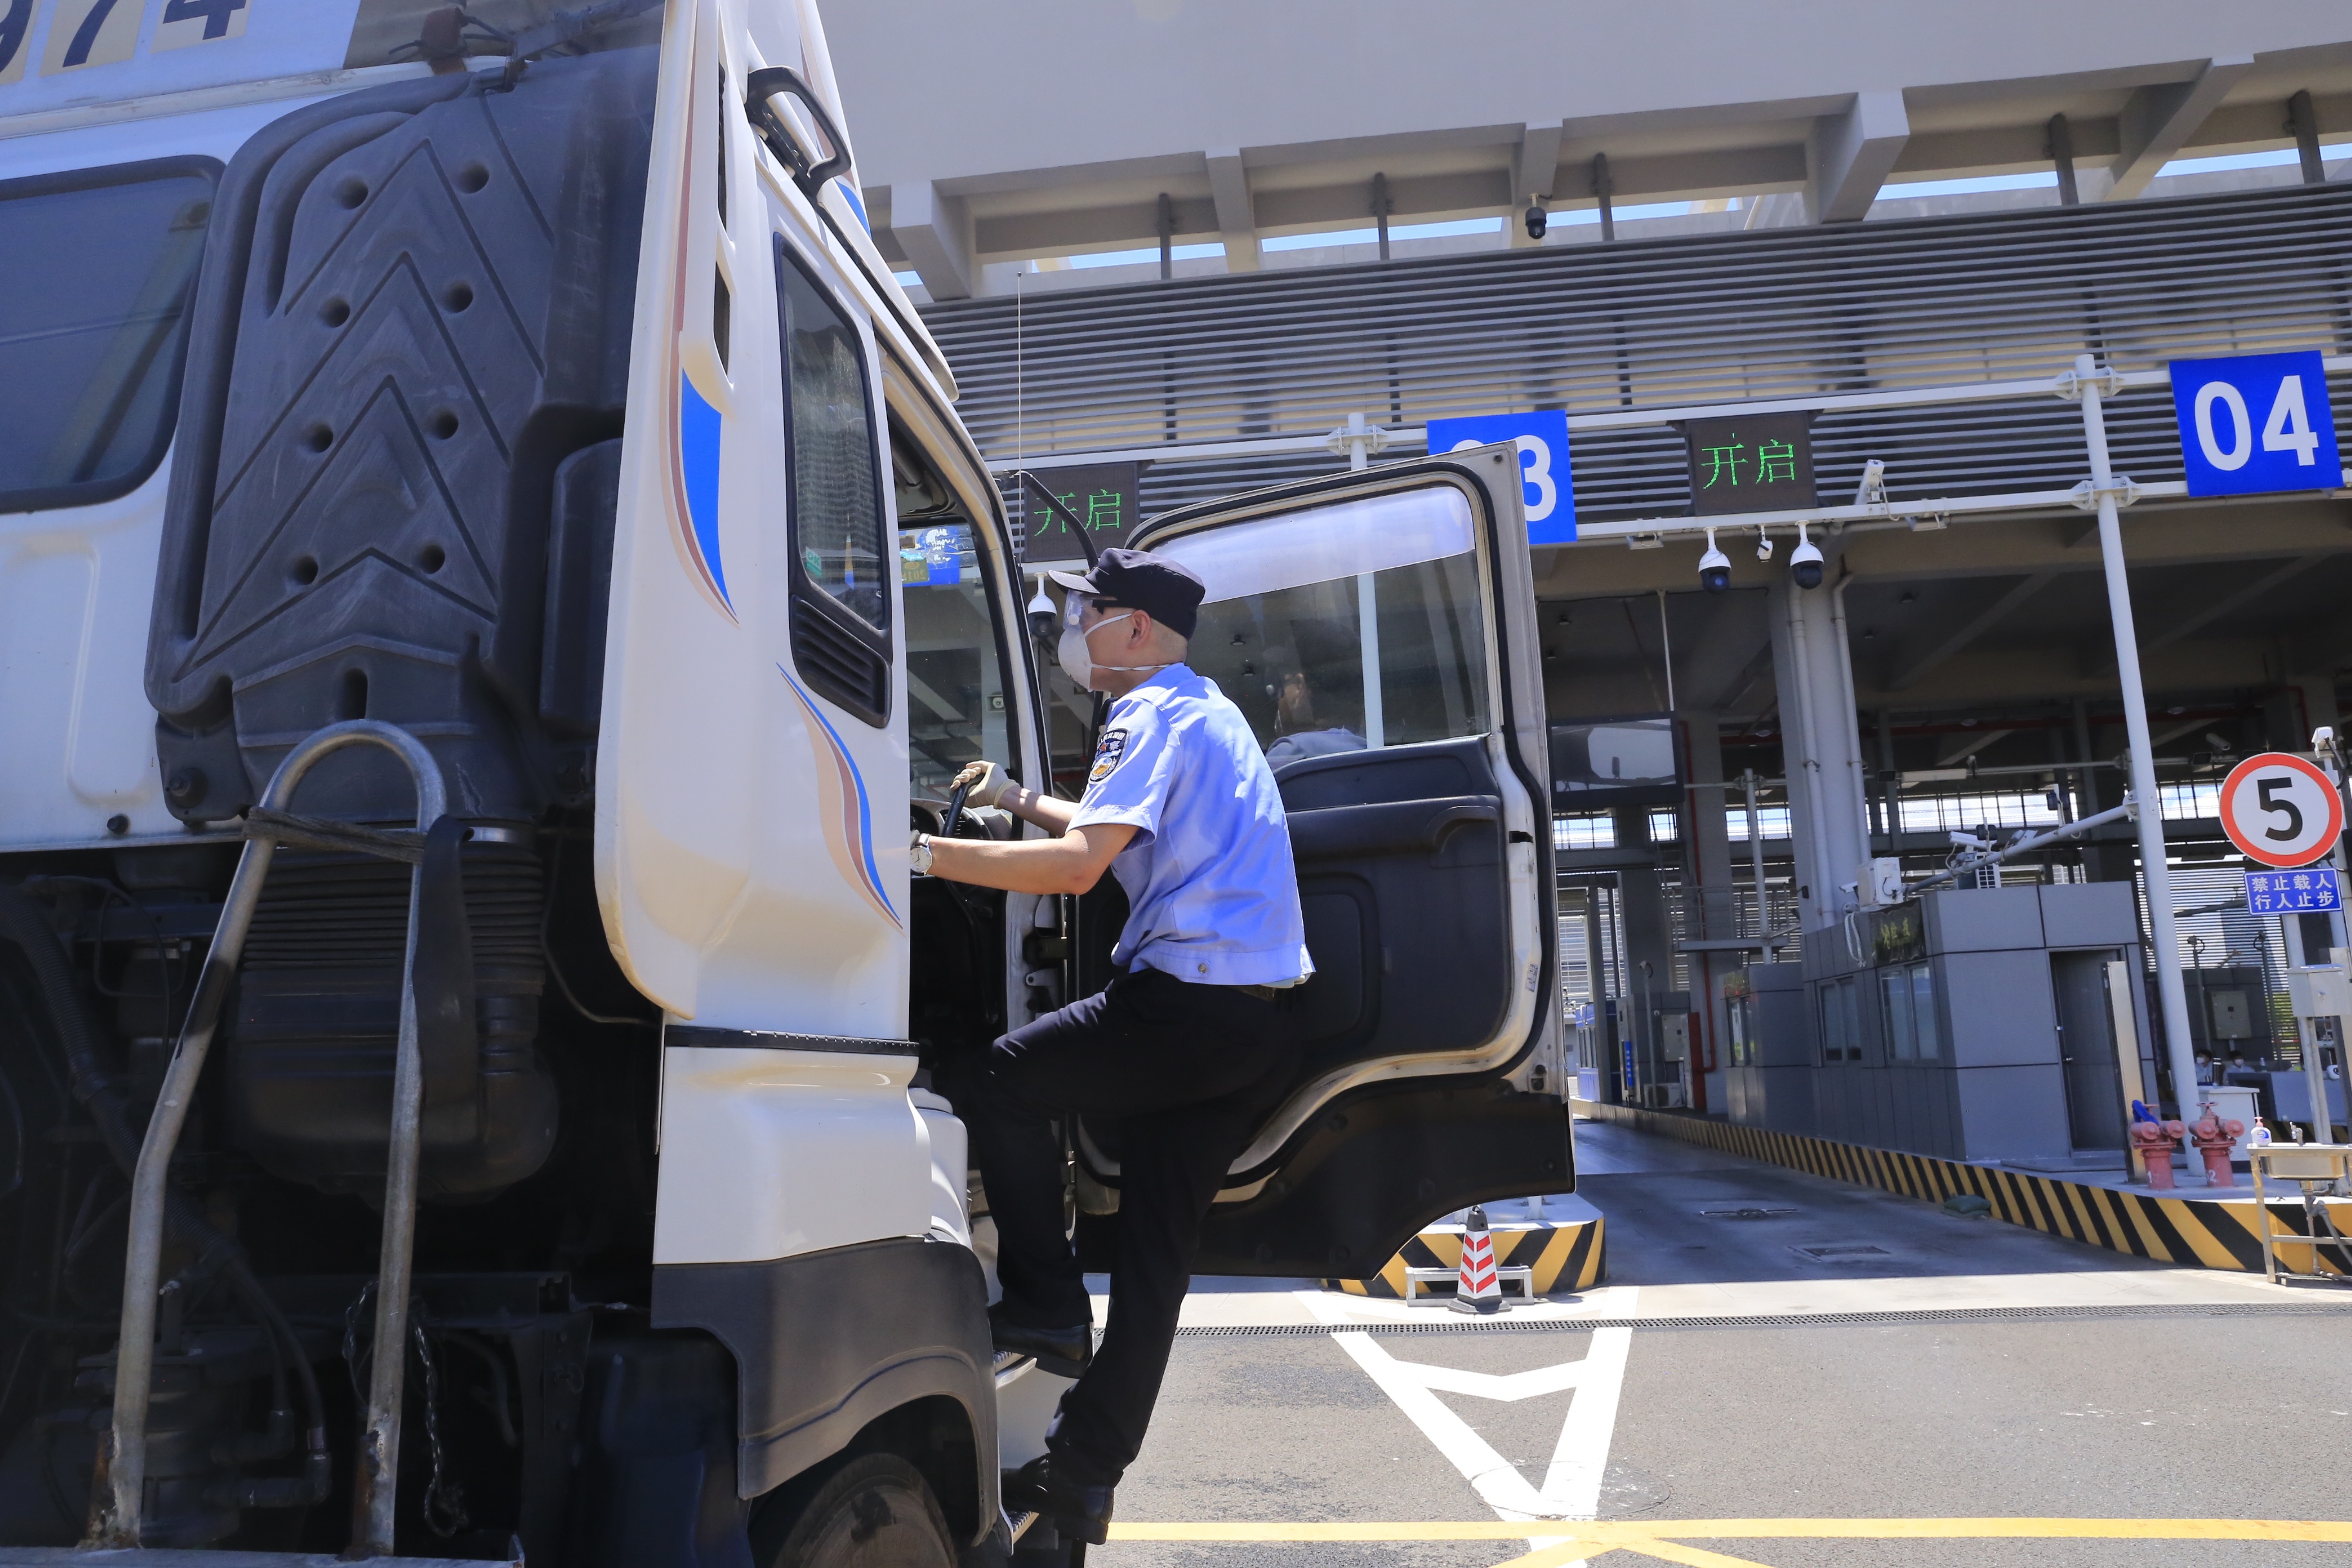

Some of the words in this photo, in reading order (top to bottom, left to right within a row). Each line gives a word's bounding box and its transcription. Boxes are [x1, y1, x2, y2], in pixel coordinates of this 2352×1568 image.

[2195, 375, 2319, 471] 04
[1701, 438, 1795, 489] 开启
[1034, 488, 1121, 536] 开启
[2257, 777, 2303, 841] 5
[2251, 873, 2333, 893] 禁止载人
[2255, 890, 2335, 910] 行人止步
